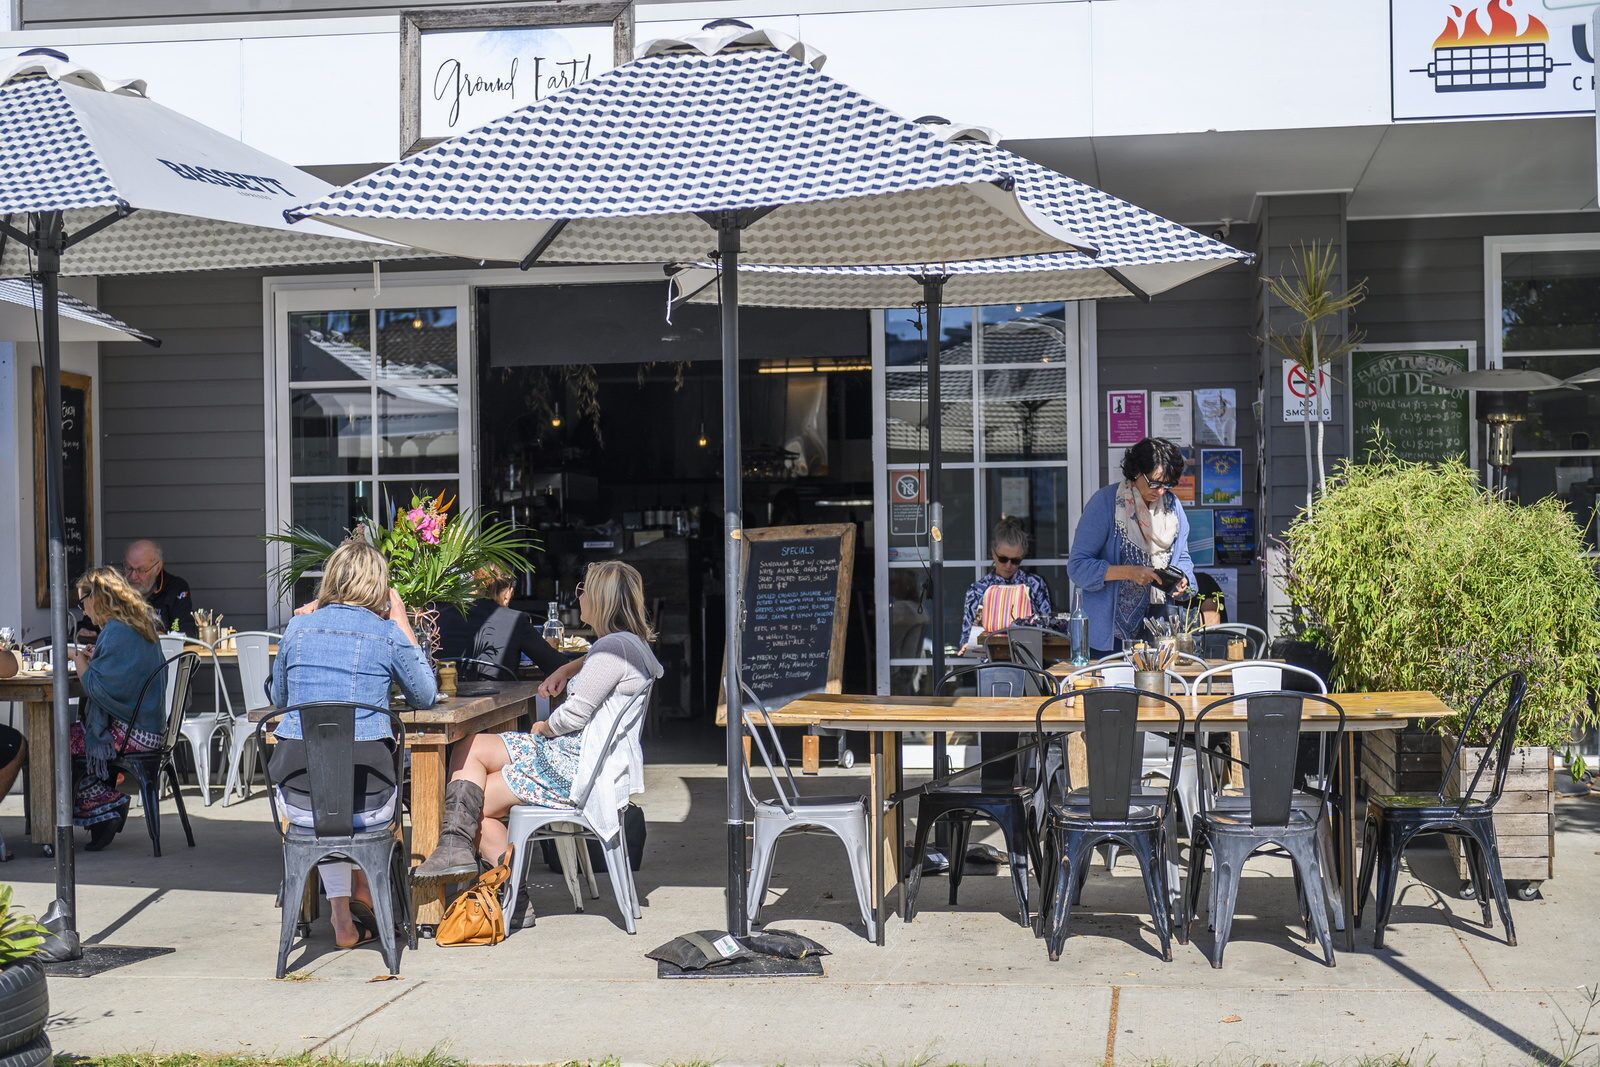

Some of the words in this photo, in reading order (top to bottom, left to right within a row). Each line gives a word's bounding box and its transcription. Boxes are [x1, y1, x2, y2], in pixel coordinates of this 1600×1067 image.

[434, 58, 519, 128] Ground
[156, 158, 297, 198] BASSETT
[1356, 358, 1397, 384] EVERY
[1367, 373, 1400, 396] HOT
[1285, 408, 1330, 416] SMOKIG
[781, 546, 815, 557] SPECIALS
